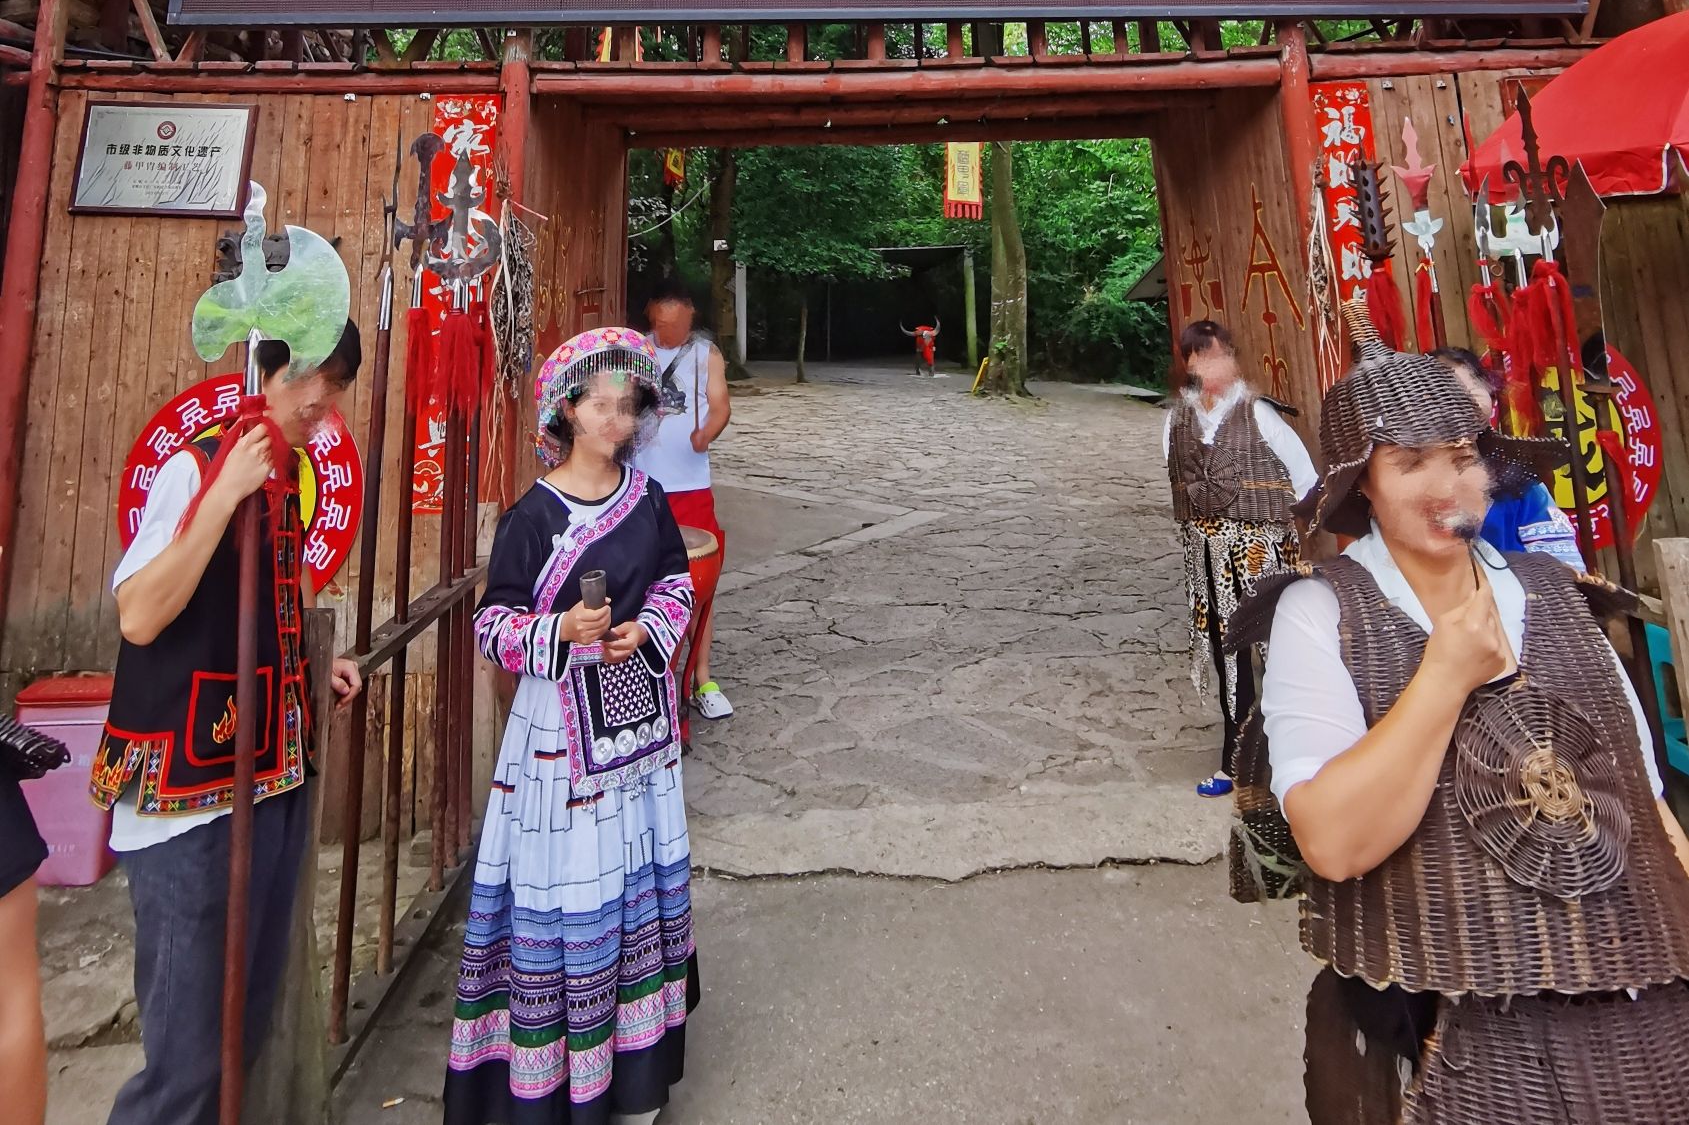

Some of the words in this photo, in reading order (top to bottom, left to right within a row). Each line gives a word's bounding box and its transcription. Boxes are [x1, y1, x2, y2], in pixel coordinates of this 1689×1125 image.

[106, 144, 222, 157] 市级非物质文化遗产
